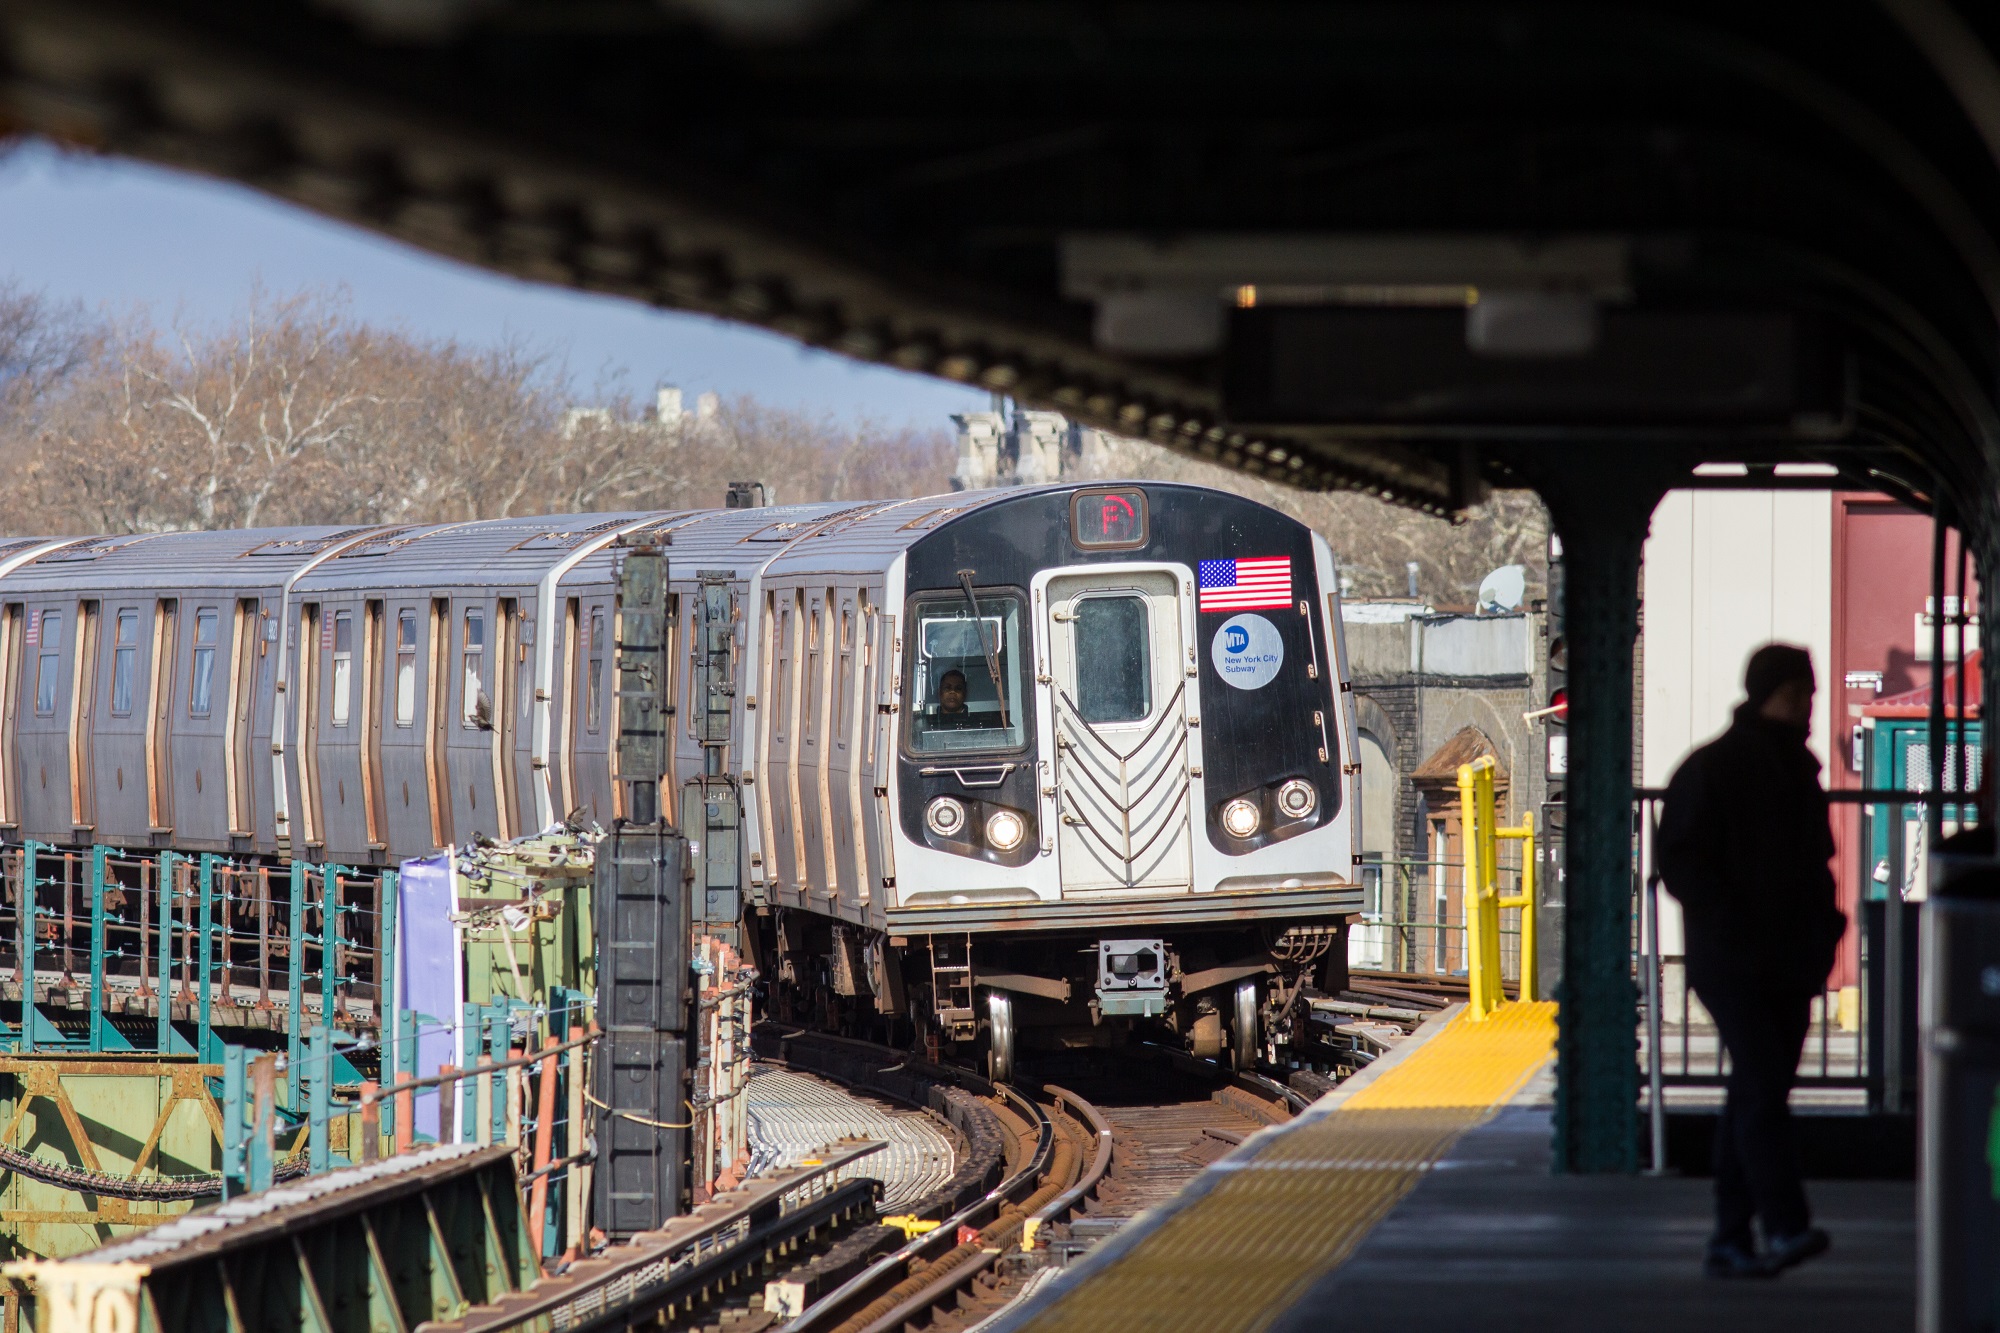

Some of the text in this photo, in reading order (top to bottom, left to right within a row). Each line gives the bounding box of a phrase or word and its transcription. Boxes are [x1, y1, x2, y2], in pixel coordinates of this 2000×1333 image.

[1102, 505, 1118, 534] F
[1224, 630, 1247, 649] MTA
[1225, 654, 1278, 664] New York City
[1225, 665, 1256, 673] Subway
